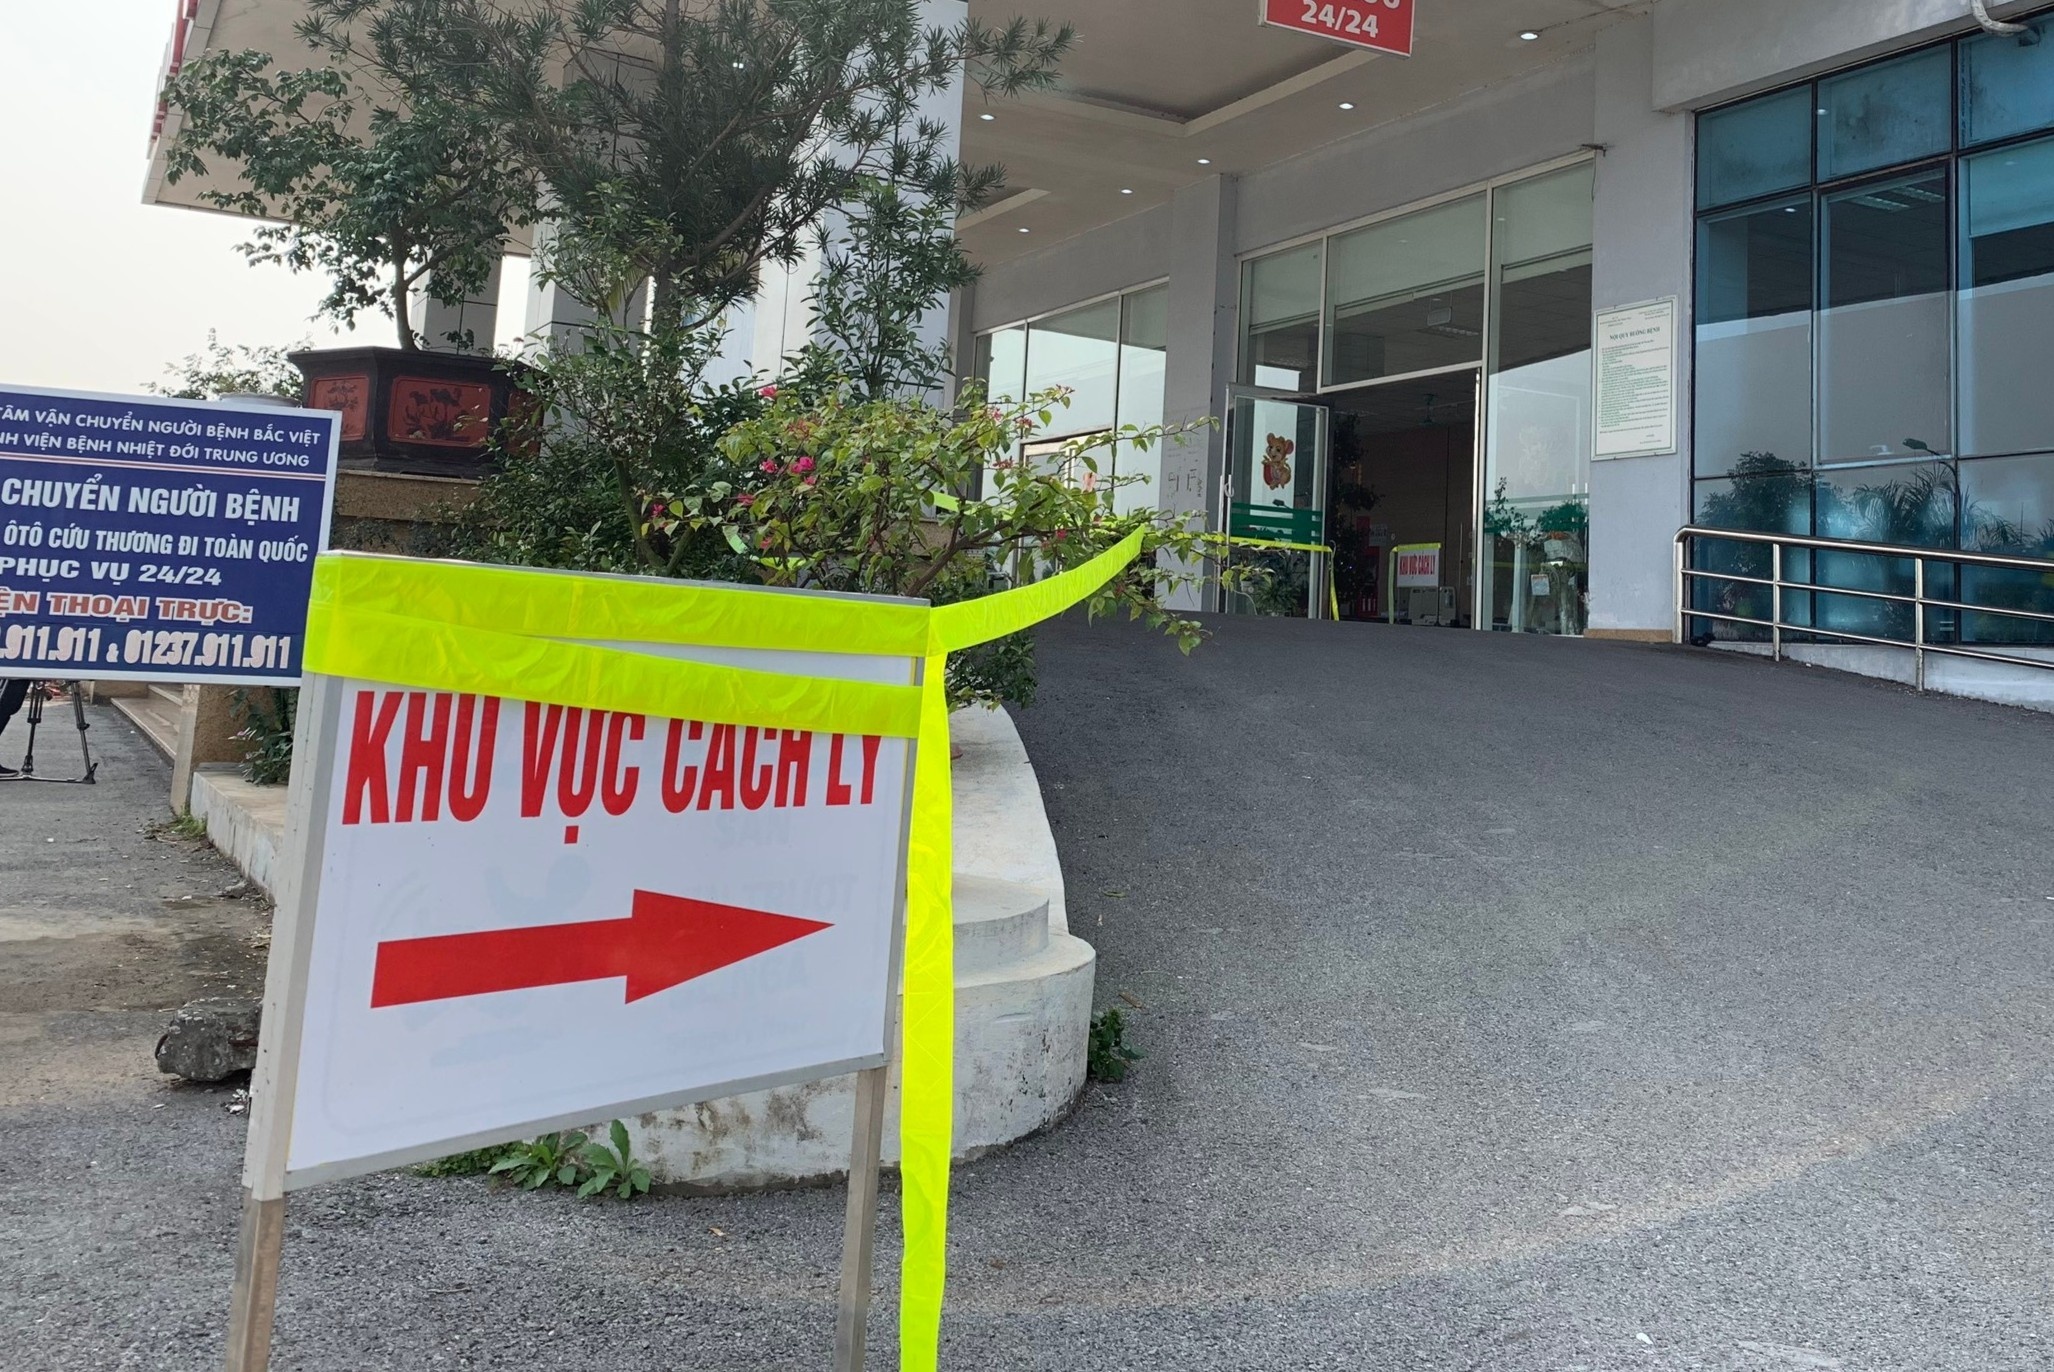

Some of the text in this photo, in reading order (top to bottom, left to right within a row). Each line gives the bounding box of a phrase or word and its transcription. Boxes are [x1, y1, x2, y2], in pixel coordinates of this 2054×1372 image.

[1301, 1, 1379, 38] 24/24
[35, 409, 71, 427] VẬN
[75, 411, 144, 432] CHUYỂN
[148, 418, 202, 437] NGƯỜI
[206, 423, 249, 441] BỆNH
[253, 424, 285, 443] BẮC
[289, 429, 321, 447] VIỆT
[23, 432, 62, 450] VIỆN
[66, 435, 112, 453] BỆNH
[117, 440, 165, 459] NHIỆT
[169, 443, 199, 459] ĐỚI
[204, 447, 258, 463] TRUNG
[263, 452, 310, 467] ƯƠNG
[1, 473, 300, 526] CHUYỂN NGƯỜI BỆNH
[3, 520, 309, 563] ÔTÔ CỨU THƯƠNG ĐI TOÀN QUỐC
[0, 556, 222, 586] PHỤC VỤ 24/24
[47, 591, 150, 623] THOẠI
[156, 596, 253, 626] TRỰC:
[0, 624, 101, 663] .911.911
[124, 629, 291, 669] 01237.911.911
[342, 691, 500, 823] KHU
